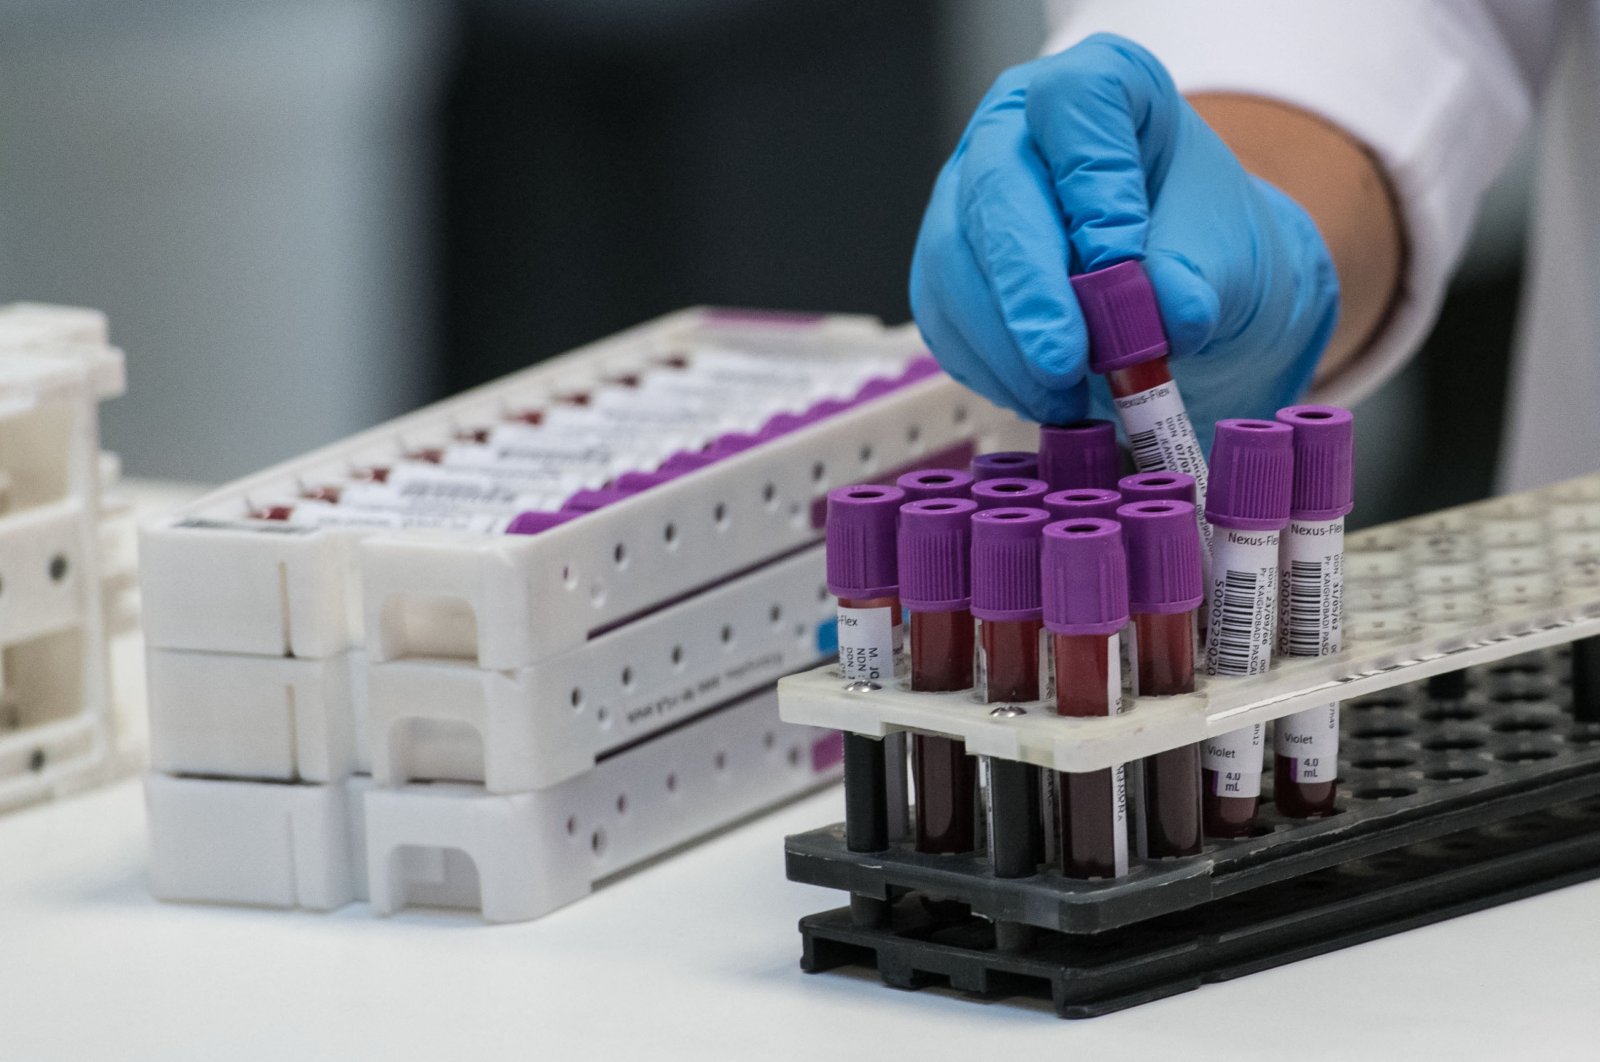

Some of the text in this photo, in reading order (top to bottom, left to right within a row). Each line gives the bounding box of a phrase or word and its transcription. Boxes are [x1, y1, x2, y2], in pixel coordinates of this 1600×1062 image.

[846, 647, 854, 668] DDN
[856, 647, 867, 672] NDN
[1283, 732, 1313, 745] Violet
[1207, 745, 1236, 759] Violet
[1303, 758, 1319, 768] 4.0
[1225, 772, 1242, 782] 4.0
[1303, 769, 1318, 778] mL
[1225, 782, 1240, 792] mL
